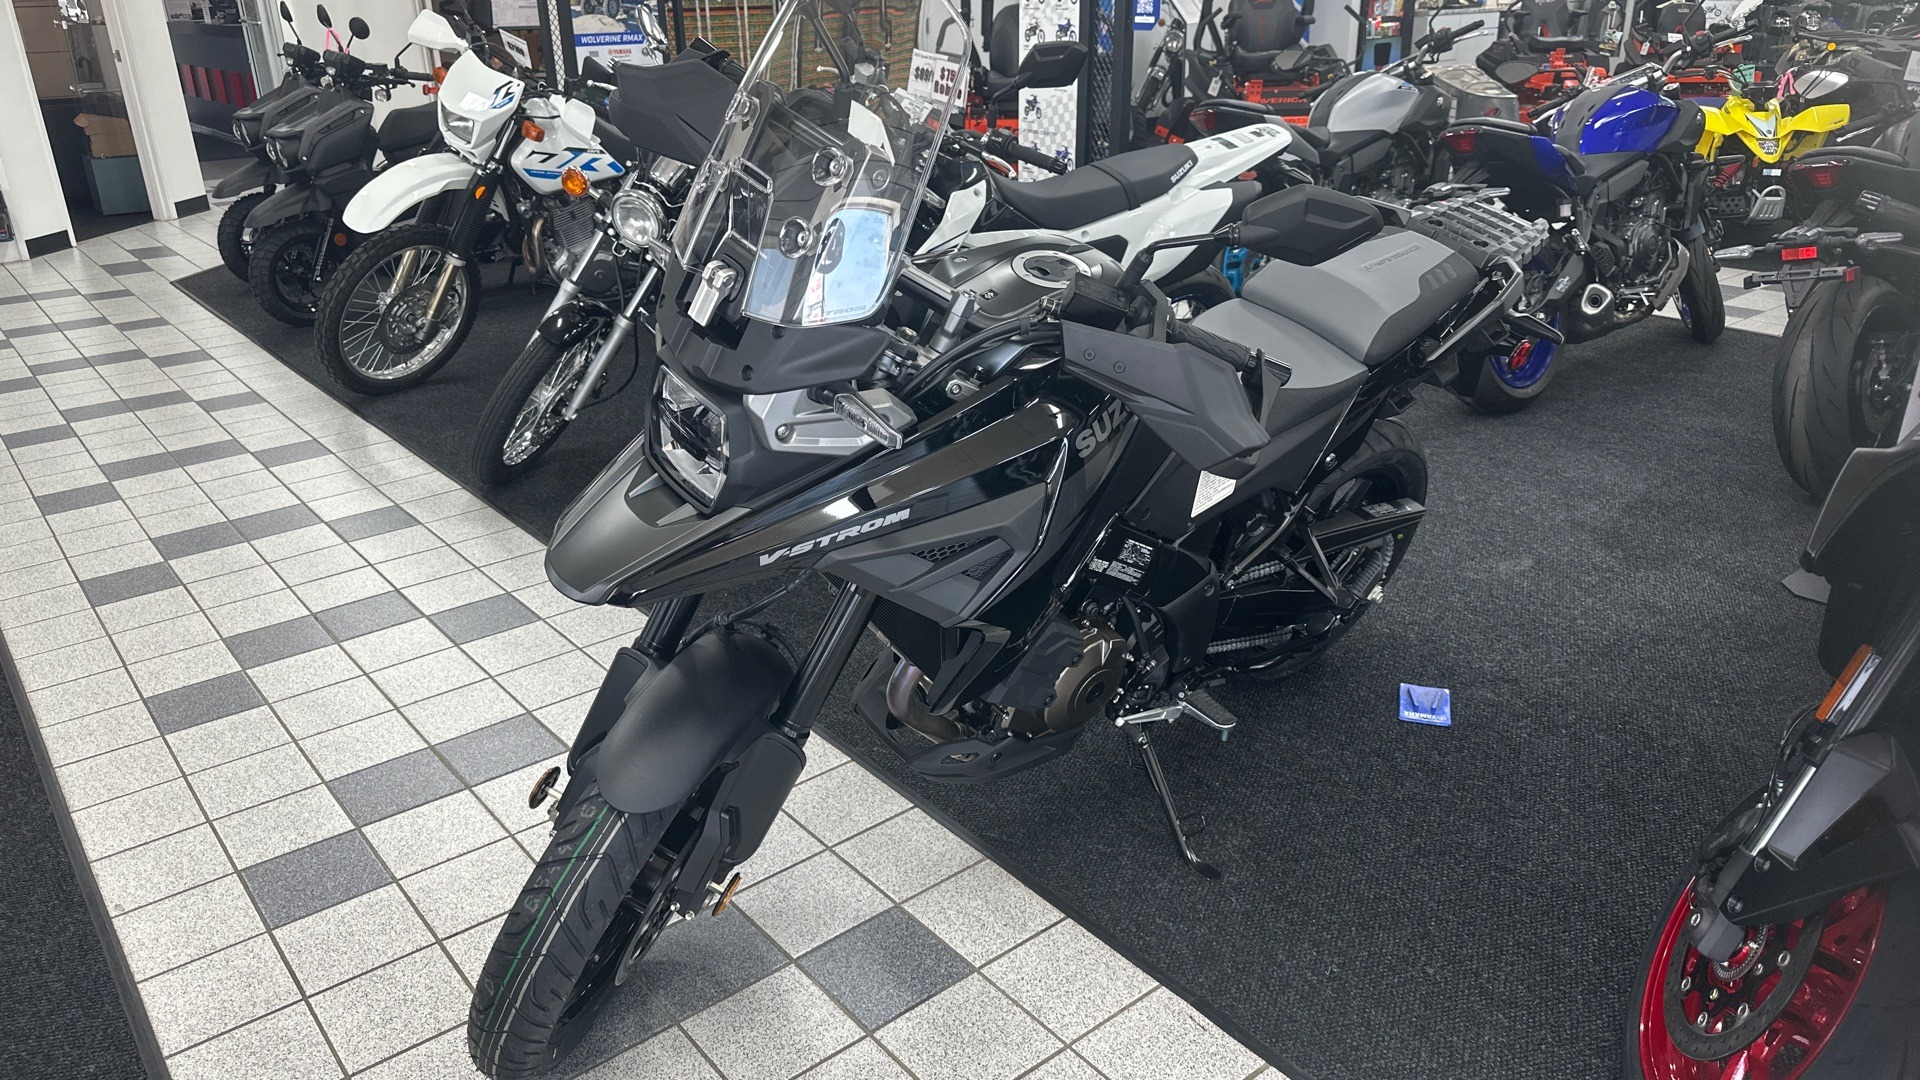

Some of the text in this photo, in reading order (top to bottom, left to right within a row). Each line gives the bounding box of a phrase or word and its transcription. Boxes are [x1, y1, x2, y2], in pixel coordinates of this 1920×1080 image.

[581, 33, 643, 44] WOLVERINE RMAX
[1170, 159, 1193, 183] SUZUKI
[1075, 398, 1130, 459] SUZ
[759, 507, 911, 567] V-STROM
[1403, 710, 1437, 721] YAMAHA
